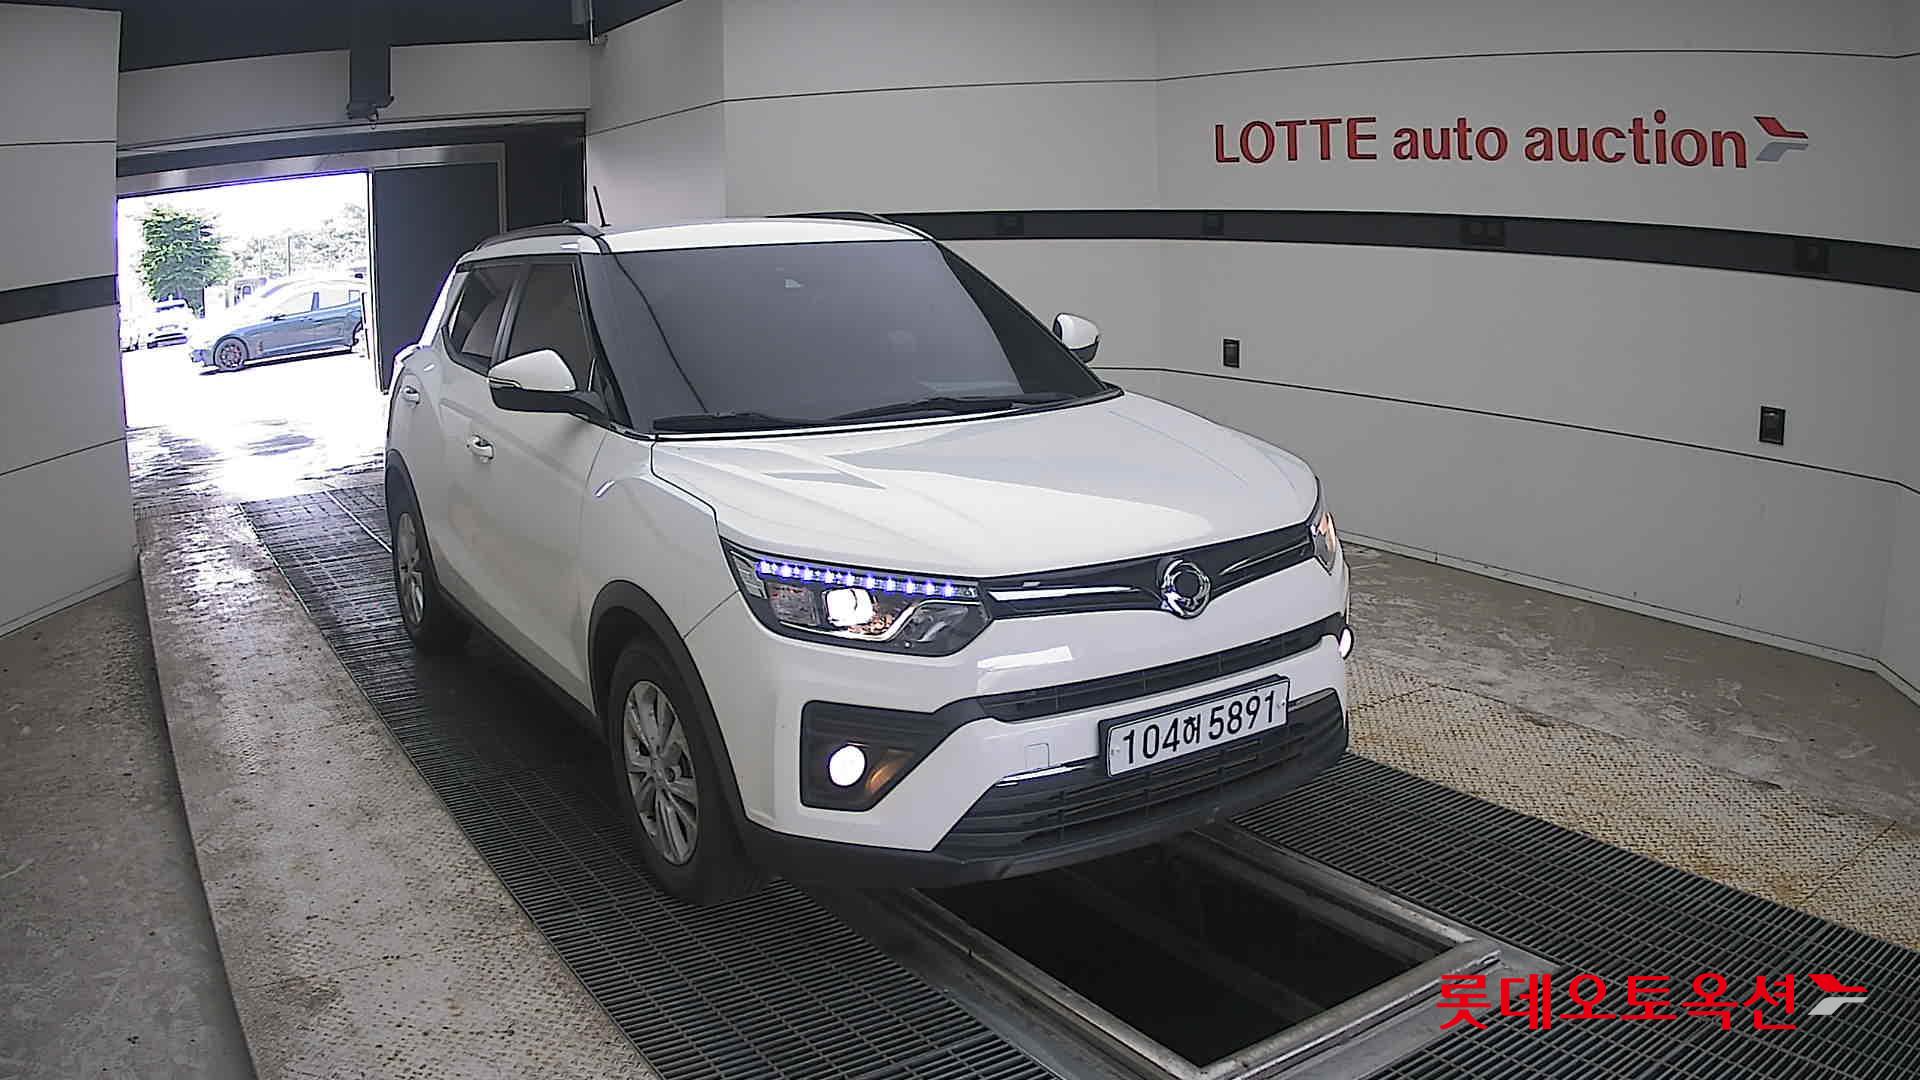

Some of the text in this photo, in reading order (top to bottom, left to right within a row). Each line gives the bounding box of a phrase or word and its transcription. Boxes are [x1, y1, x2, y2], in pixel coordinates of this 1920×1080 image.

[1214, 109, 1748, 169] LOTTE auto auction
[1123, 690, 1275, 765] 104허 5891
